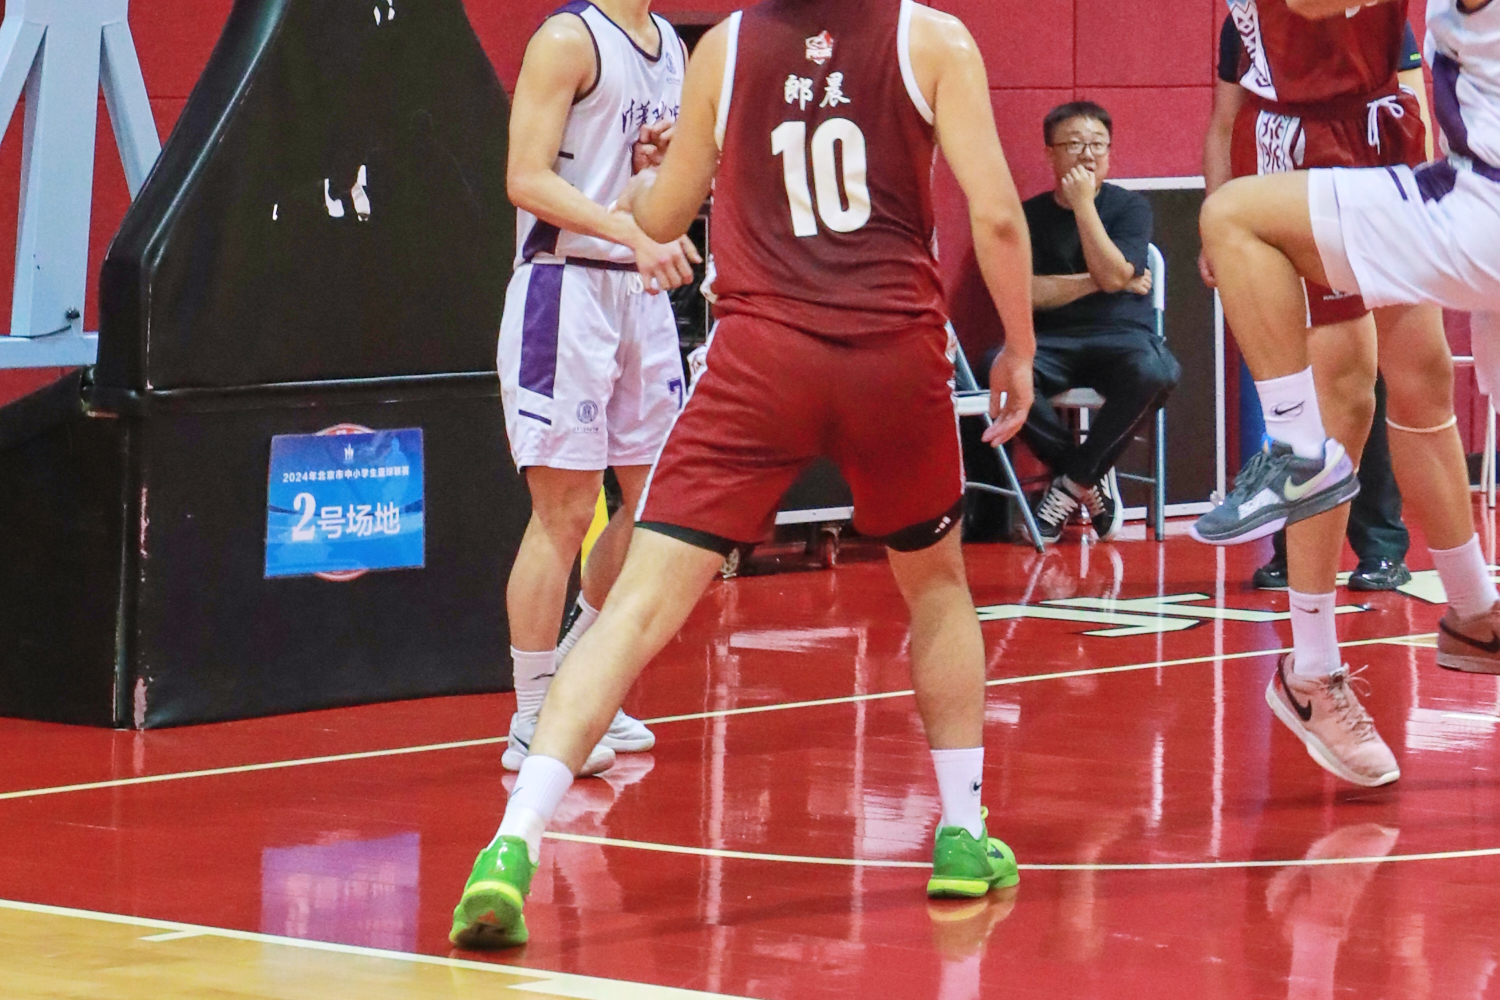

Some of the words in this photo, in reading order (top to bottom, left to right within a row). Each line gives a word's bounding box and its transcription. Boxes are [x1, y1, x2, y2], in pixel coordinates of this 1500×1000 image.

[771, 117, 871, 237] 10
[291, 492, 401, 541] 2号场地
